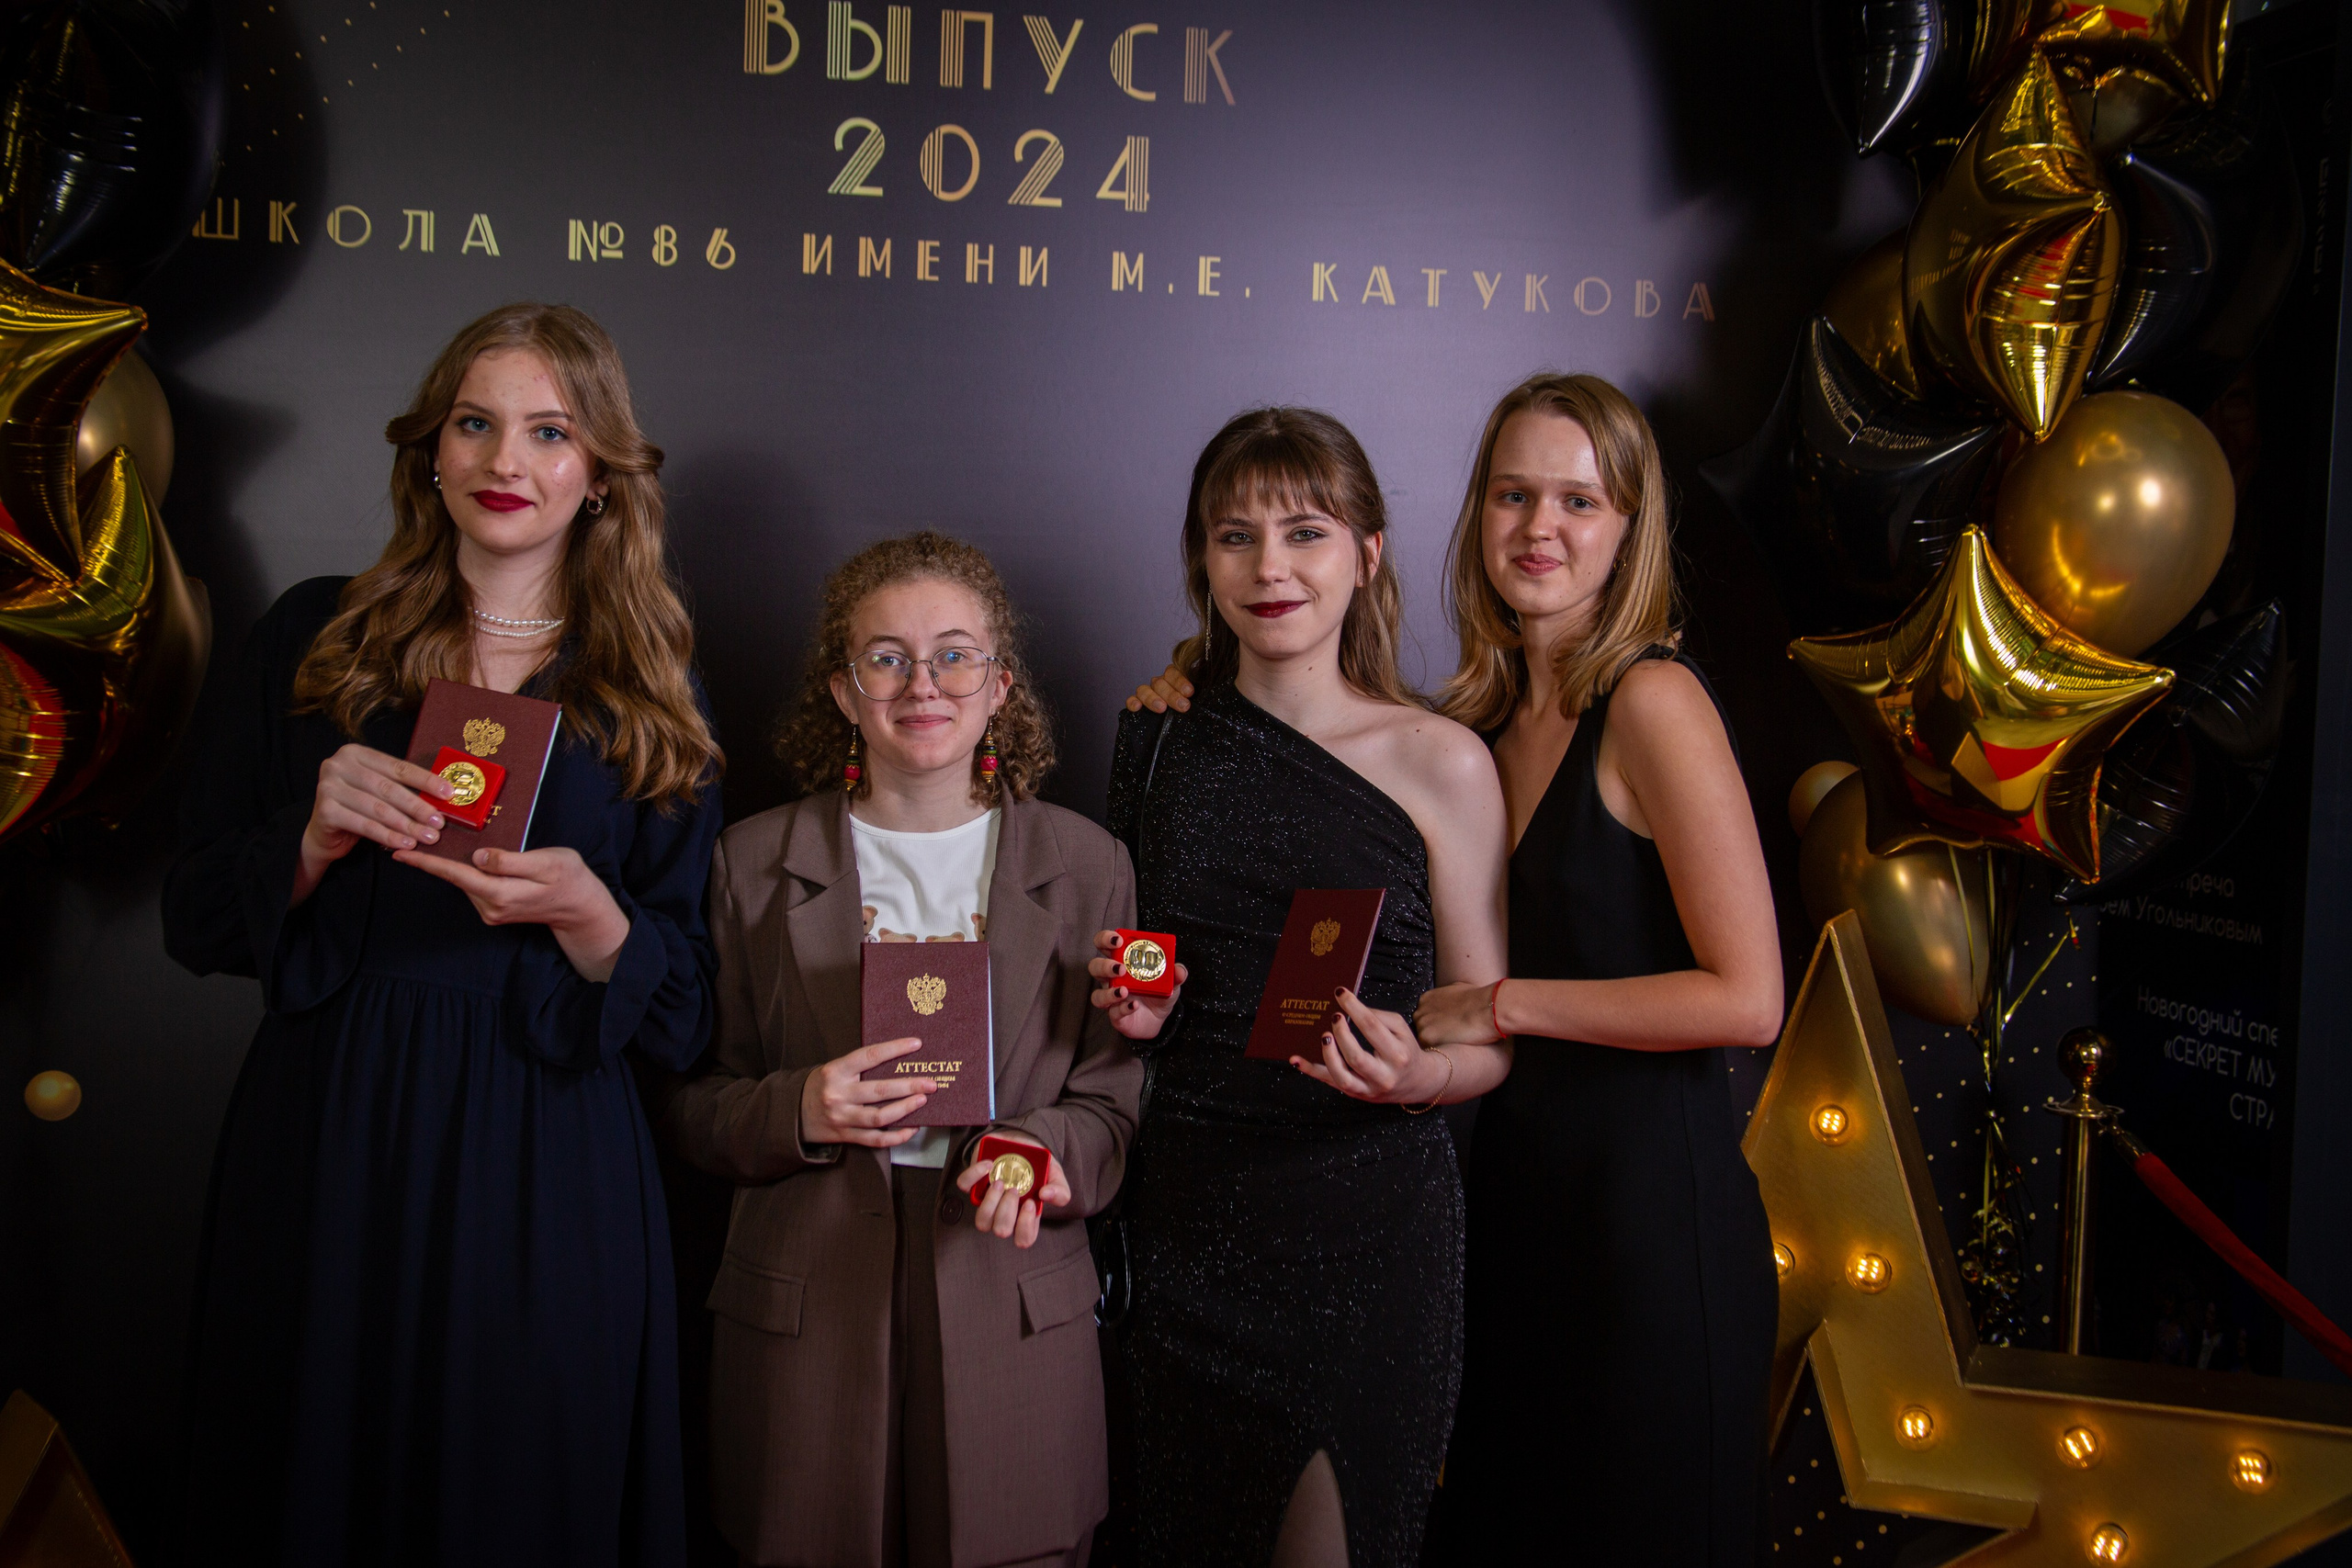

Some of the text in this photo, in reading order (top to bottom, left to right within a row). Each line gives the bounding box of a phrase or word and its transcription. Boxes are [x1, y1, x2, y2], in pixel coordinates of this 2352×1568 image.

[743, 0, 1236, 106] ВЫПУСК
[827, 117, 1150, 212] 2024
[193, 197, 1716, 322] ШКОЛА №86 ИМЕНИ М.Е. КАТУКОВА
[2099, 894, 2264, 945] ем Угольниковым
[1280, 998, 1330, 1011] АТТЕСТАТ
[2137, 984, 2243, 1039] Новогодний
[894, 1060, 963, 1073] АТТЕСТАТ
[2164, 1034, 2243, 1078] «СЕКРЕТ
